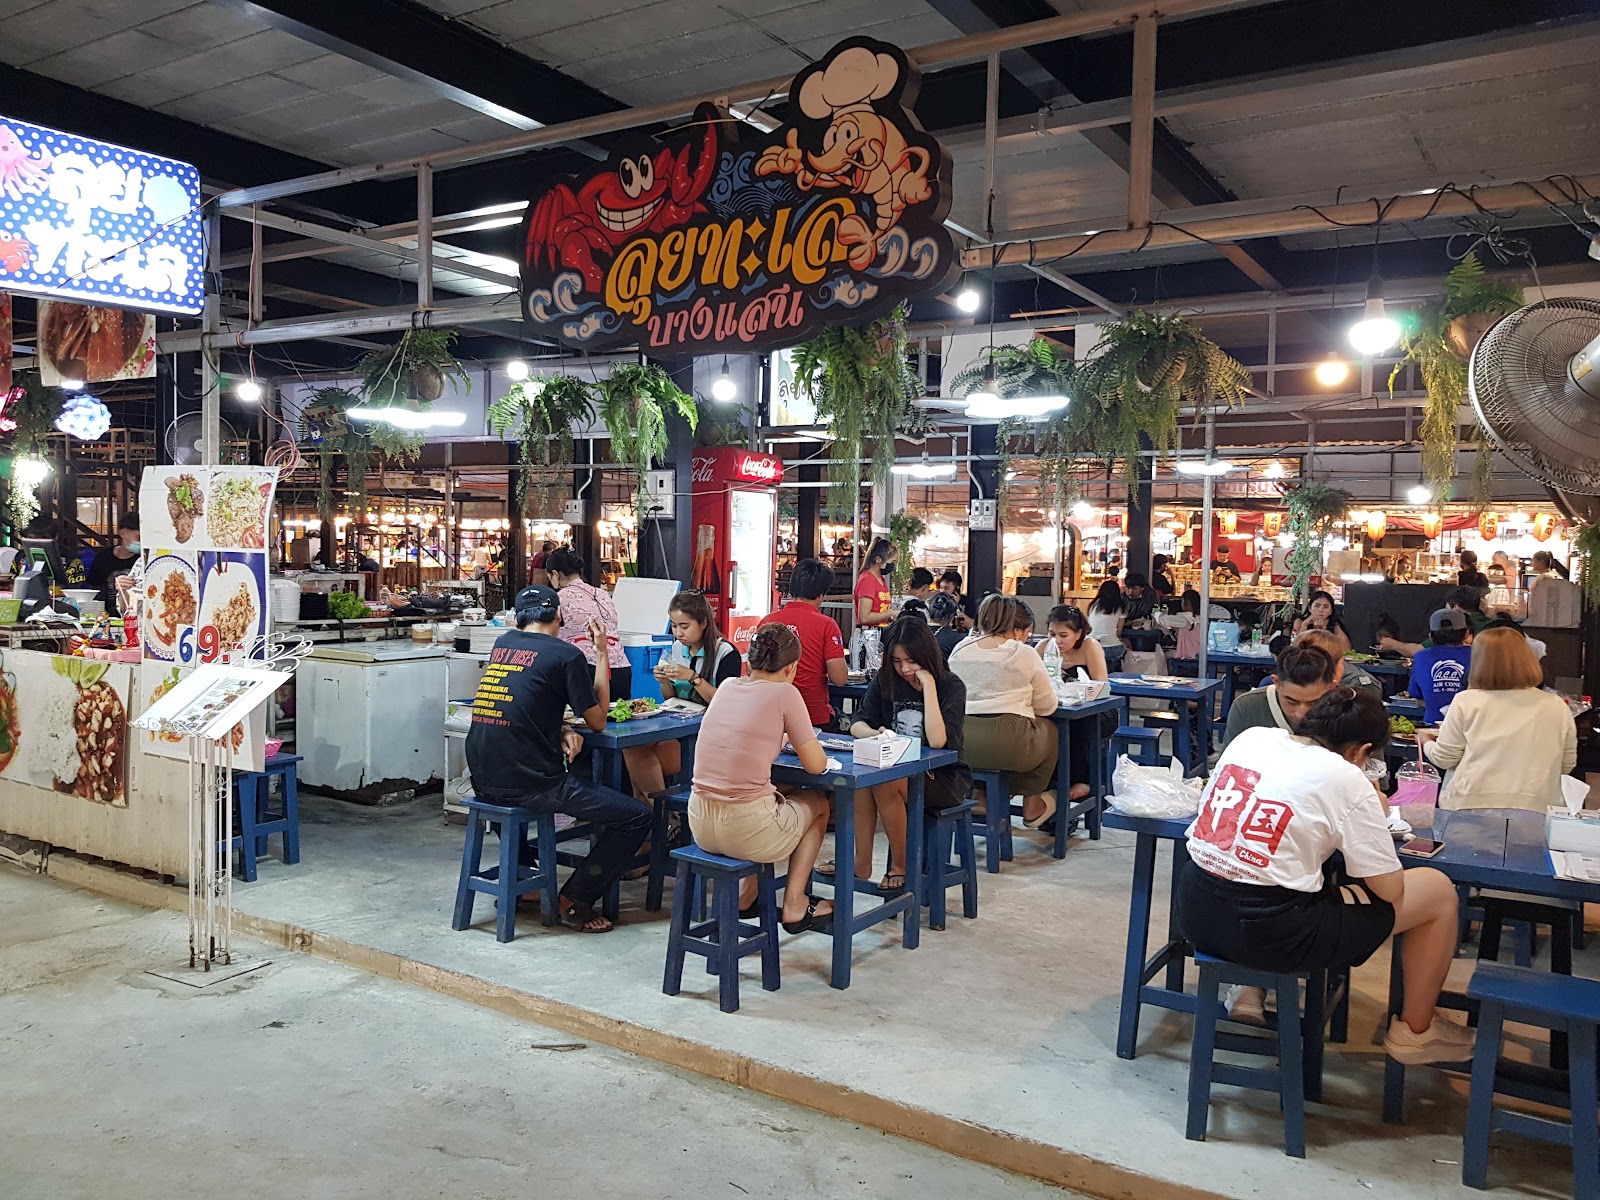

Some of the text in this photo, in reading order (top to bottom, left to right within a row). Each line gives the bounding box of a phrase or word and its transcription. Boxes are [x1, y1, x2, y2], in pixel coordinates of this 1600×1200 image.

[606, 197, 857, 325] ลุยทะเล
[648, 284, 804, 347] บางแสน
[1238, 868, 1260, 881] culture
[1240, 849, 1265, 866] China
